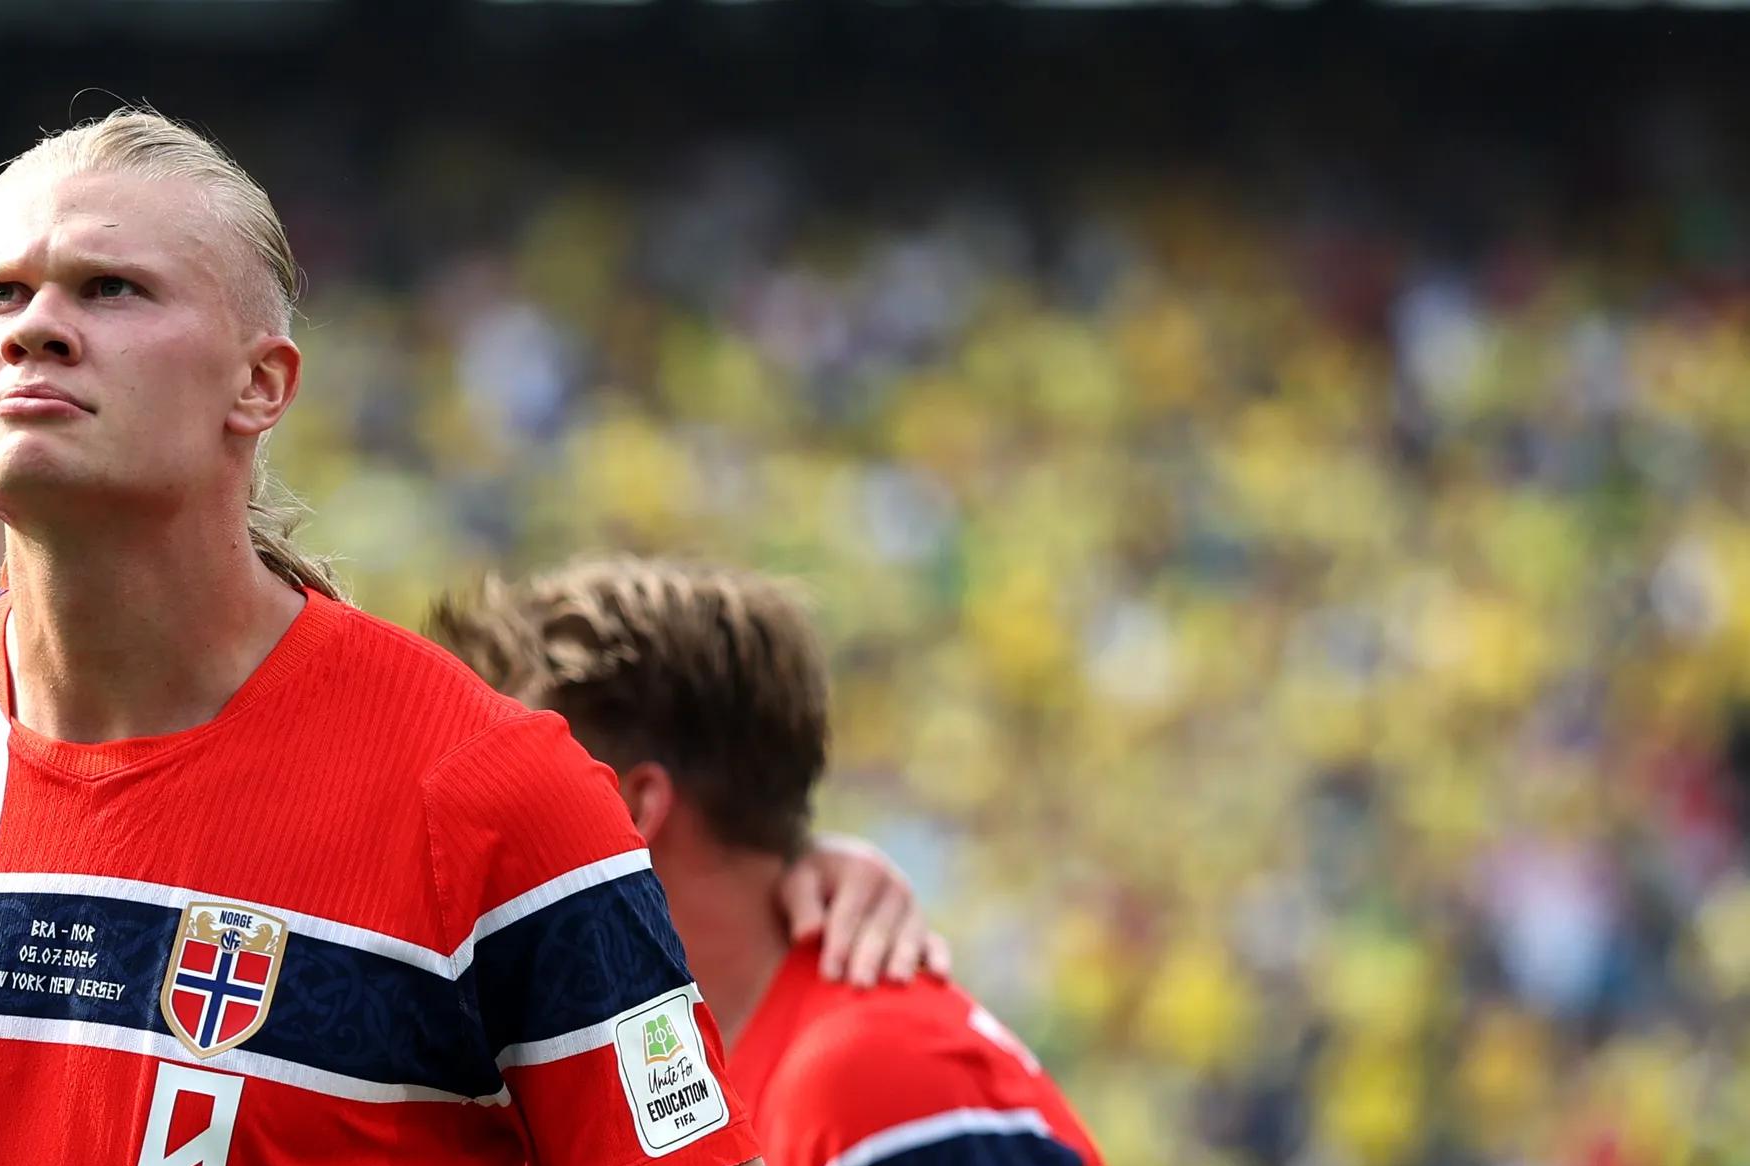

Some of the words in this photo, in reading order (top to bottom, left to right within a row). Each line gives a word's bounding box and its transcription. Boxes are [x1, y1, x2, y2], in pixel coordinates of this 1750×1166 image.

[30, 919, 56, 939] BRA
[69, 923, 96, 943] NOR
[218, 910, 254, 929] NORGE
[19, 945, 99, 968] 05.07.2026
[10, 972, 47, 993] YORK
[49, 976, 75, 995] NEW
[75, 979, 125, 1001] JERSEY
[648, 1065, 679, 1094] Unite
[677, 1056, 694, 1081] For
[646, 1079, 710, 1123] EDUCATION
[674, 1112, 697, 1130] FIFA
